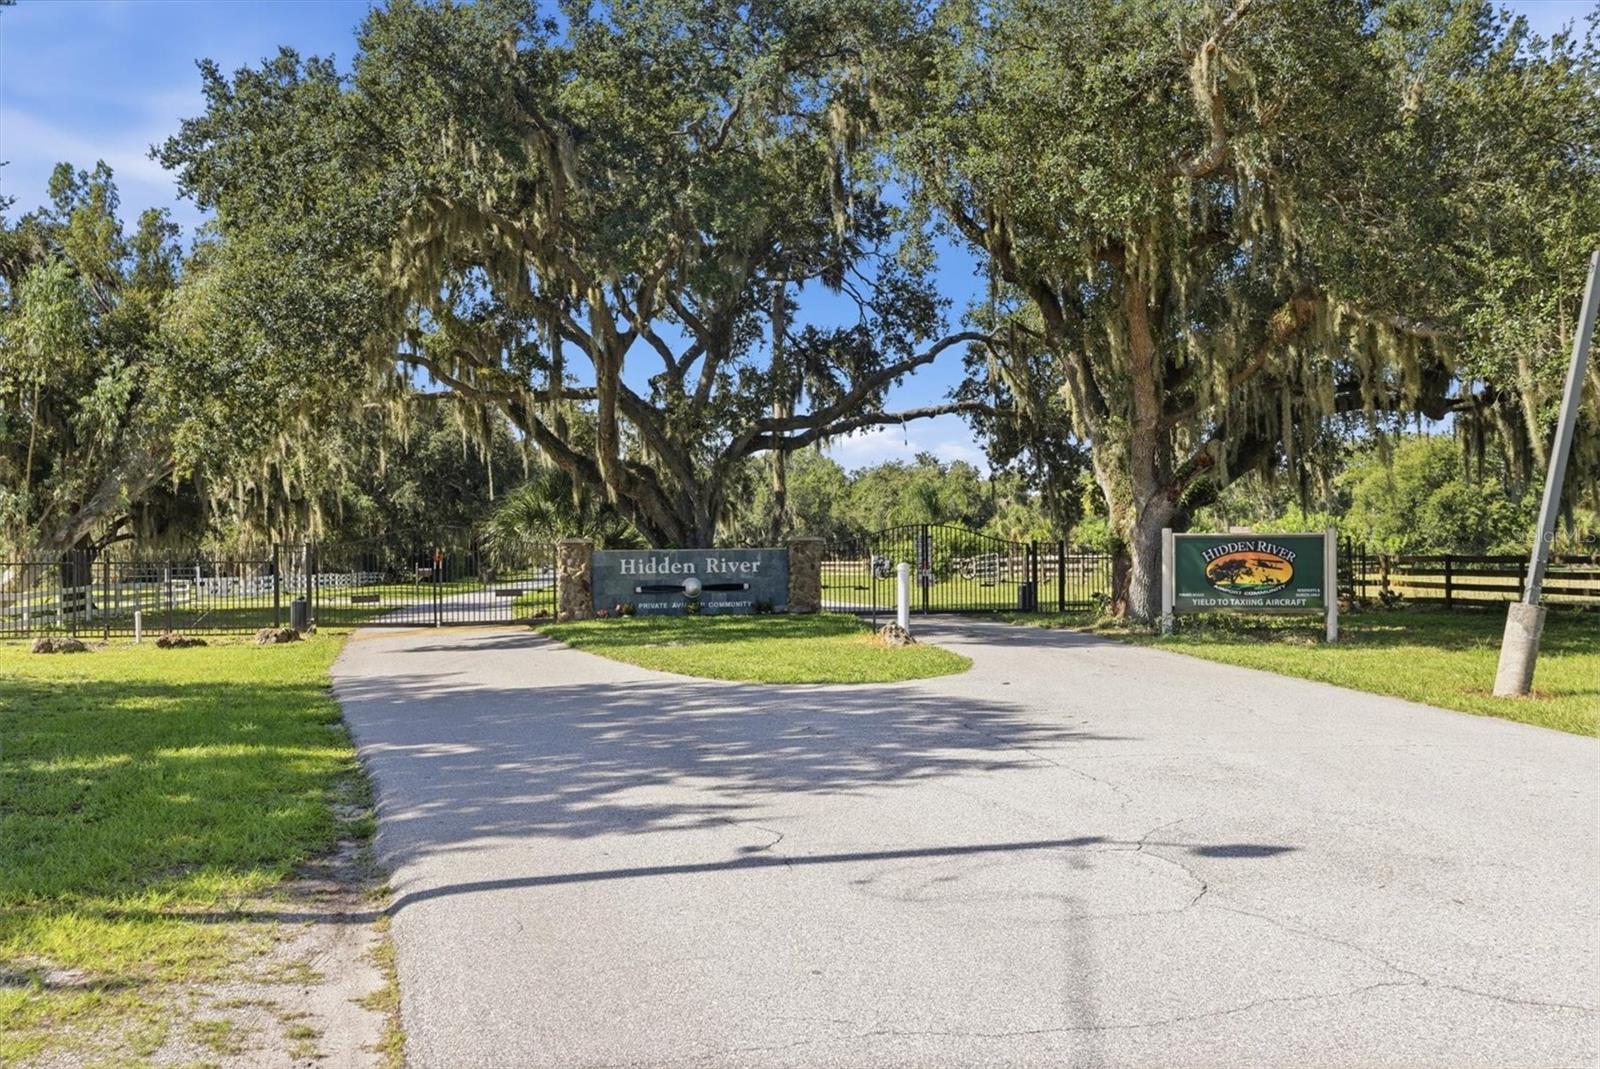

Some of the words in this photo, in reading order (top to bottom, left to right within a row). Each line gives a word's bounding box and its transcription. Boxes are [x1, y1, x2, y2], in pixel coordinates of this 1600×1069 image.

[1202, 540, 1255, 562] HIDDEN
[1257, 540, 1297, 562] RIVER
[619, 558, 696, 575] Hidden
[706, 556, 761, 573] River
[1244, 584, 1286, 596] COMMUNITY
[638, 601, 667, 609] PRIVATE
[1192, 598, 1217, 606] YIELD
[1217, 598, 1229, 606] TO
[1230, 598, 1264, 606] TAXIING
[1265, 598, 1307, 606] AIRCRAFT
